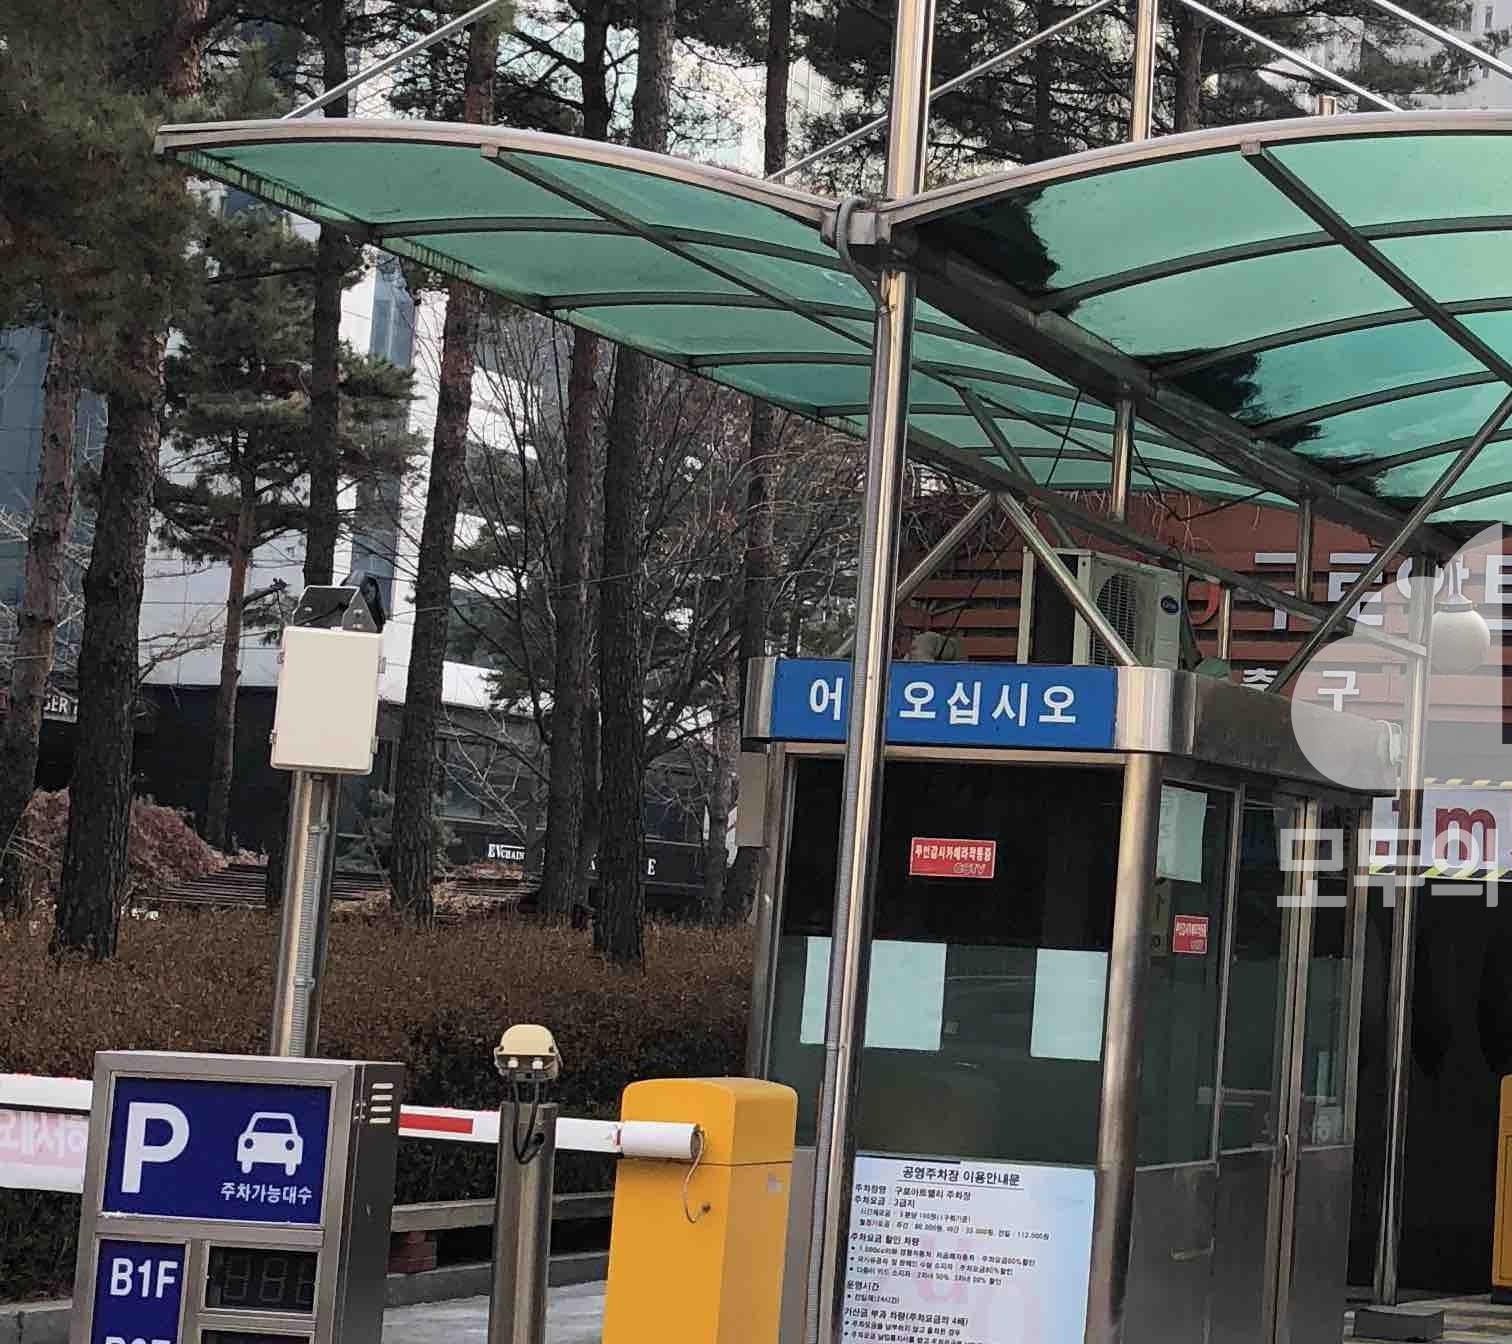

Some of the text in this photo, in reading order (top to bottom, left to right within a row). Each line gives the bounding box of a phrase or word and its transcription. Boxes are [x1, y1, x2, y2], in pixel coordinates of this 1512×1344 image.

[809, 676, 1078, 726] 어오십시오
[121, 1102, 190, 1193] P
[221, 1182, 313, 1205] 주차가능대수
[902, 1165, 1020, 1186] 공영주차장 이용안내문
[110, 1258, 178, 1298] B1F
